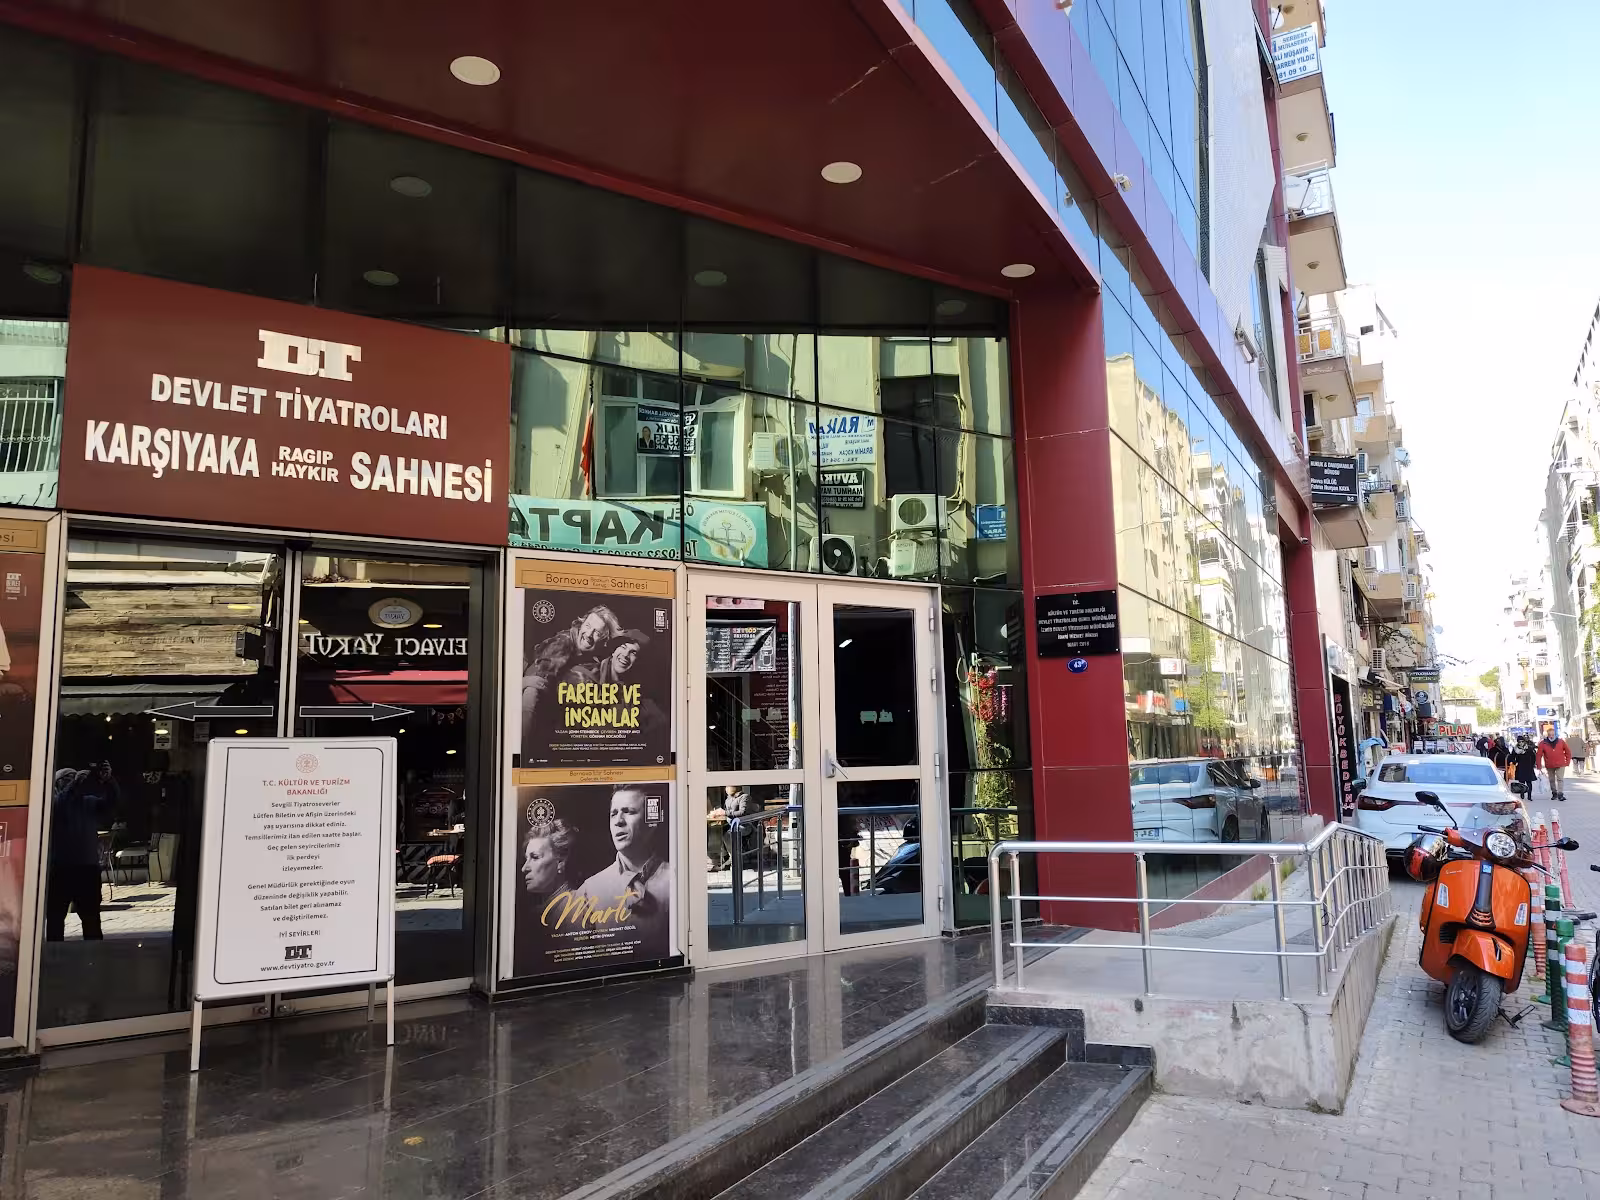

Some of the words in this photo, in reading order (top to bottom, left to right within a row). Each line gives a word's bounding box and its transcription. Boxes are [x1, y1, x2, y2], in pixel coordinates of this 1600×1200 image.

[1284, 46, 1308, 58] MÜŞAVİR
[1297, 54, 1315, 63] YILDIZ
[151, 373, 267, 415] DEVLET
[276, 386, 448, 440] TİYATROLARI
[278, 446, 334, 464] RAGIP
[85, 420, 260, 479] KARŞIYAKA
[350, 452, 494, 503] SAHNESİ
[272, 461, 339, 483] HAYKIR
[546, 574, 589, 585] Bornova
[611, 579, 648, 590] Sahnesi
[558, 682, 619, 705] FARELER
[622, 684, 641, 705] VE
[565, 706, 640, 728] İNSANLAR
[278, 778, 308, 786] KÜLTÜR
[321, 778, 350, 786] TURİZM
[343, 831, 362, 839] başlar.
[300, 880, 338, 888] gerektiğinde
[288, 892, 318, 900] değişiklik
[300, 902, 312, 910] geri
[282, 914, 328, 922] değiştirilemez.
[279, 930, 287, 938] İYİ
[260, 960, 335, 972] www.devtiyatro.gov.tr
